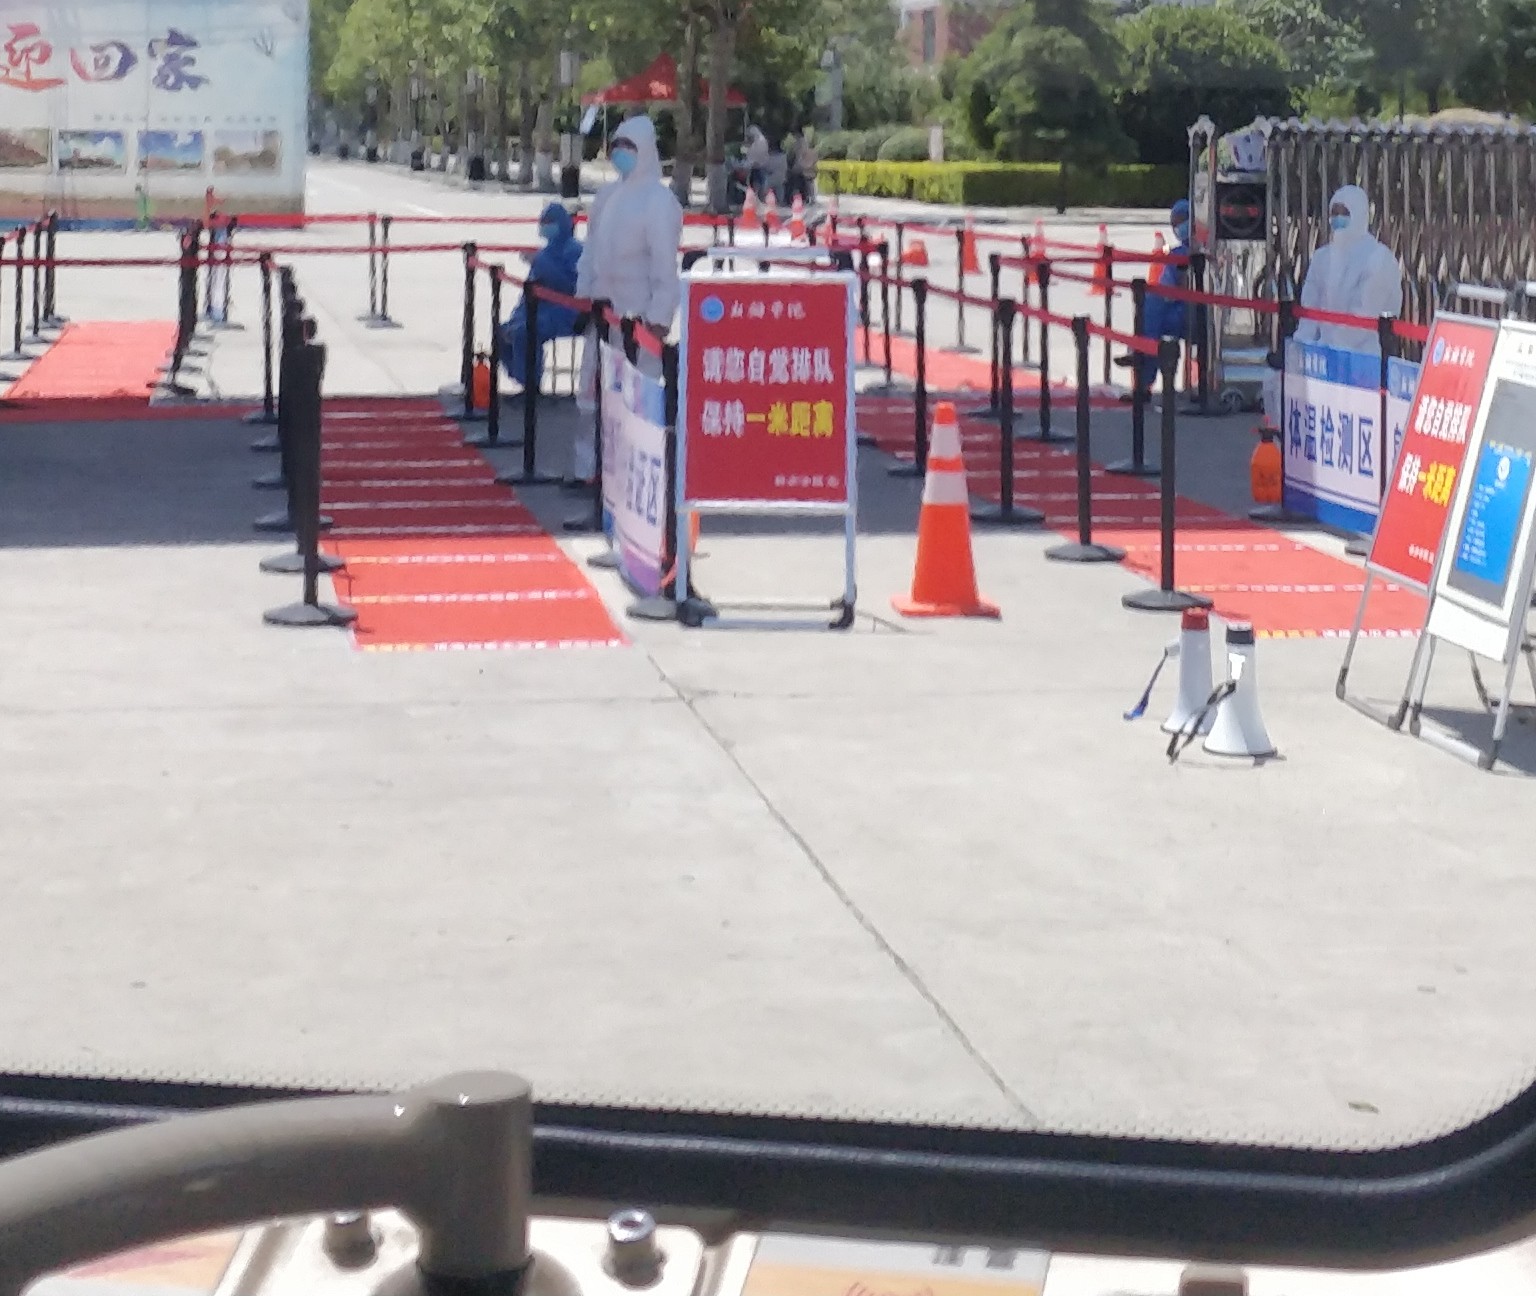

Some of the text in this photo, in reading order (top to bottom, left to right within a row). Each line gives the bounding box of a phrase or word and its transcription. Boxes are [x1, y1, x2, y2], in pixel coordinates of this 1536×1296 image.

[702, 346, 835, 384] 请您自觉排队
[702, 399, 835, 438] 保持一米距离
[1289, 397, 1374, 478] 体温检测区
